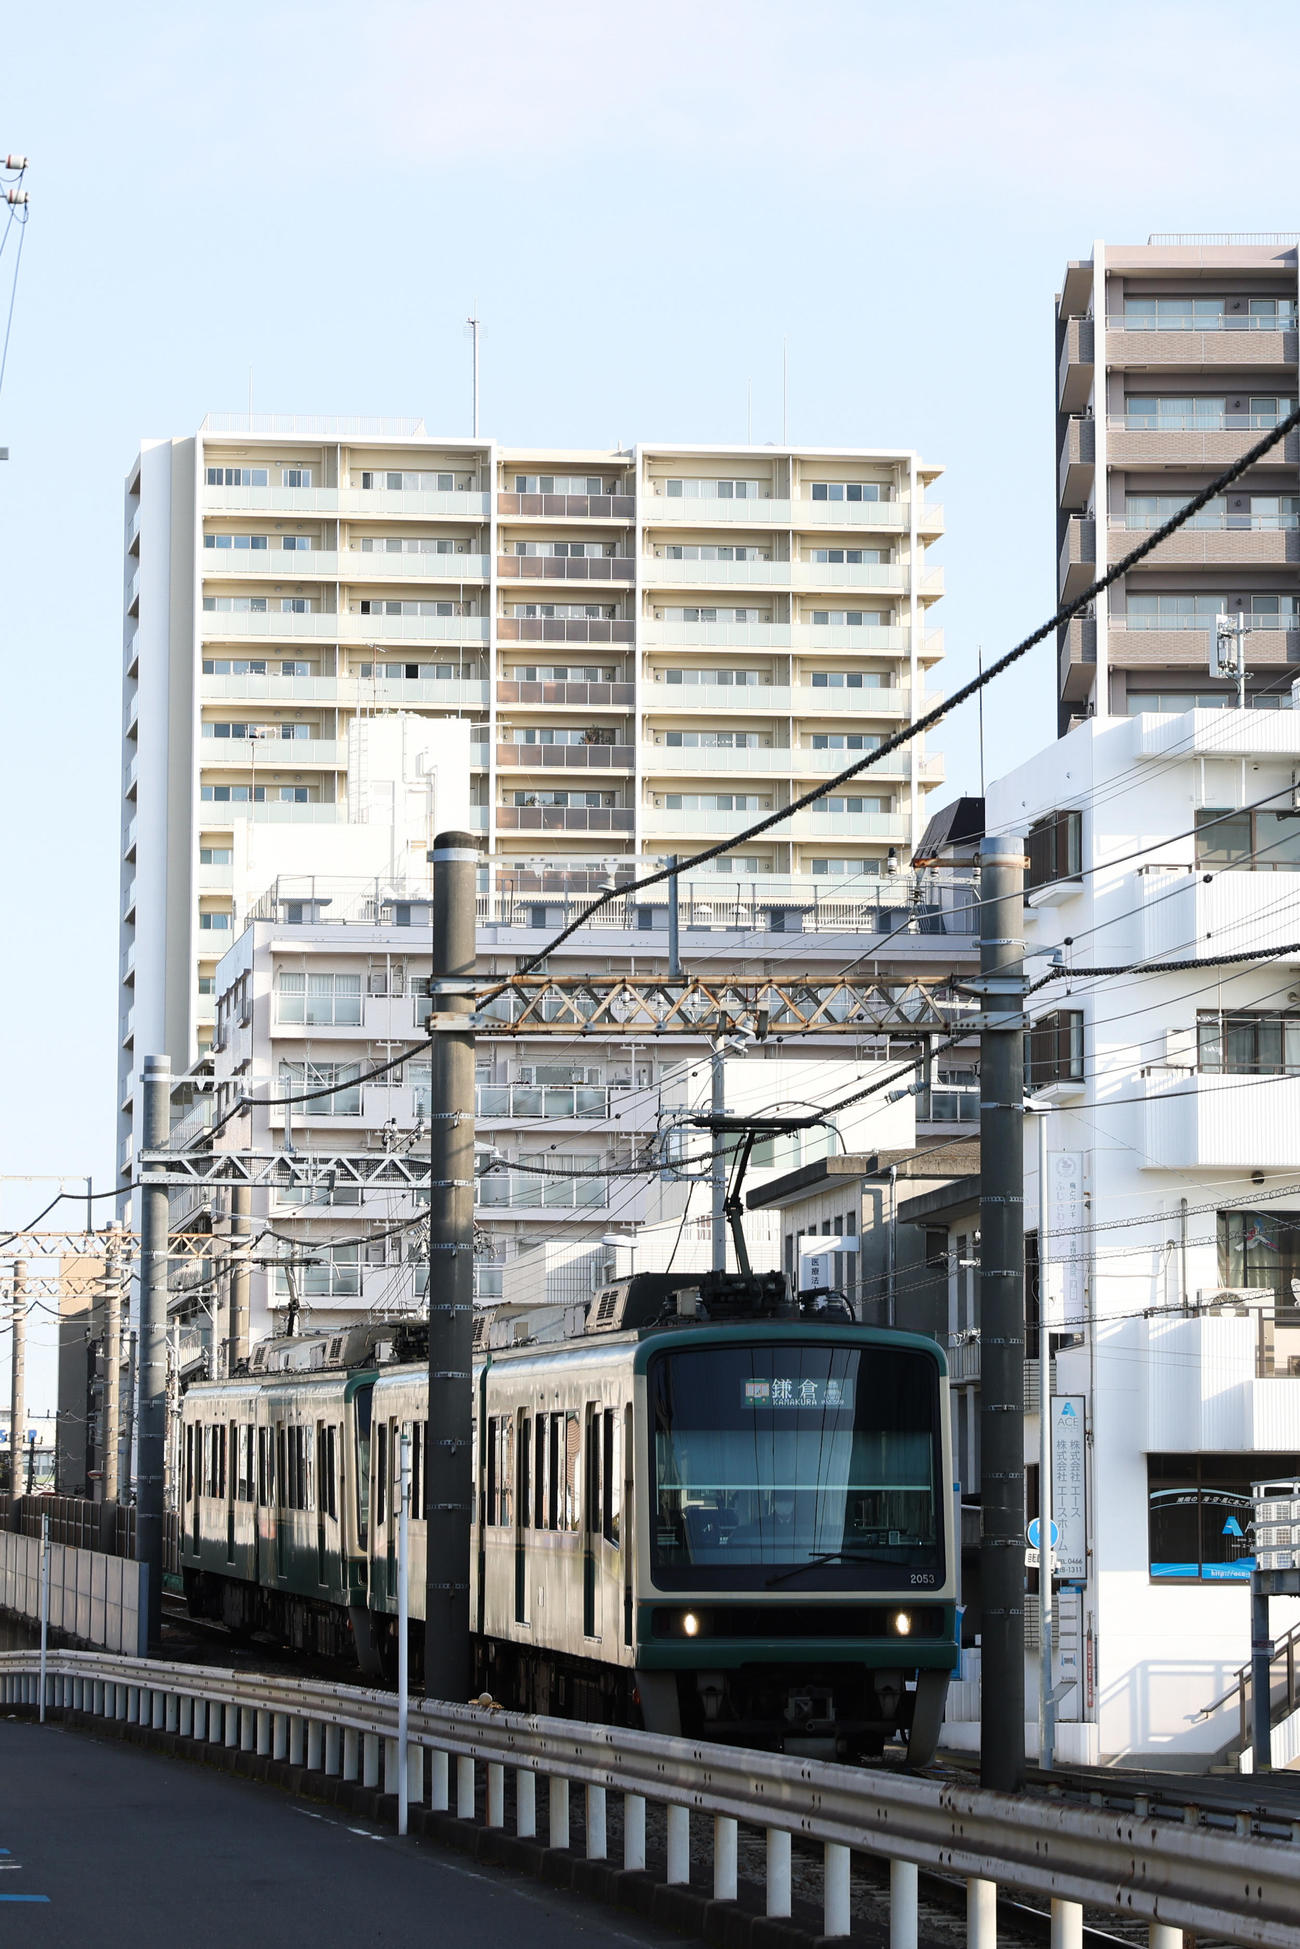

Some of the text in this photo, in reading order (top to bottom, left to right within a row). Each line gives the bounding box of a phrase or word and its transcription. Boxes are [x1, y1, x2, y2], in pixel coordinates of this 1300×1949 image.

[771, 1378, 818, 1400] 鎌倉
[772, 1398, 817, 1406] KAMAKURA
[1057, 1417, 1079, 1427] ACE
[1057, 1439, 1068, 1482] 株式会社
[1070, 1439, 1081, 1518] 株式会社 エース
[1057, 1486, 1068, 1551] エースホーム
[910, 1574, 935, 1584] 2053
